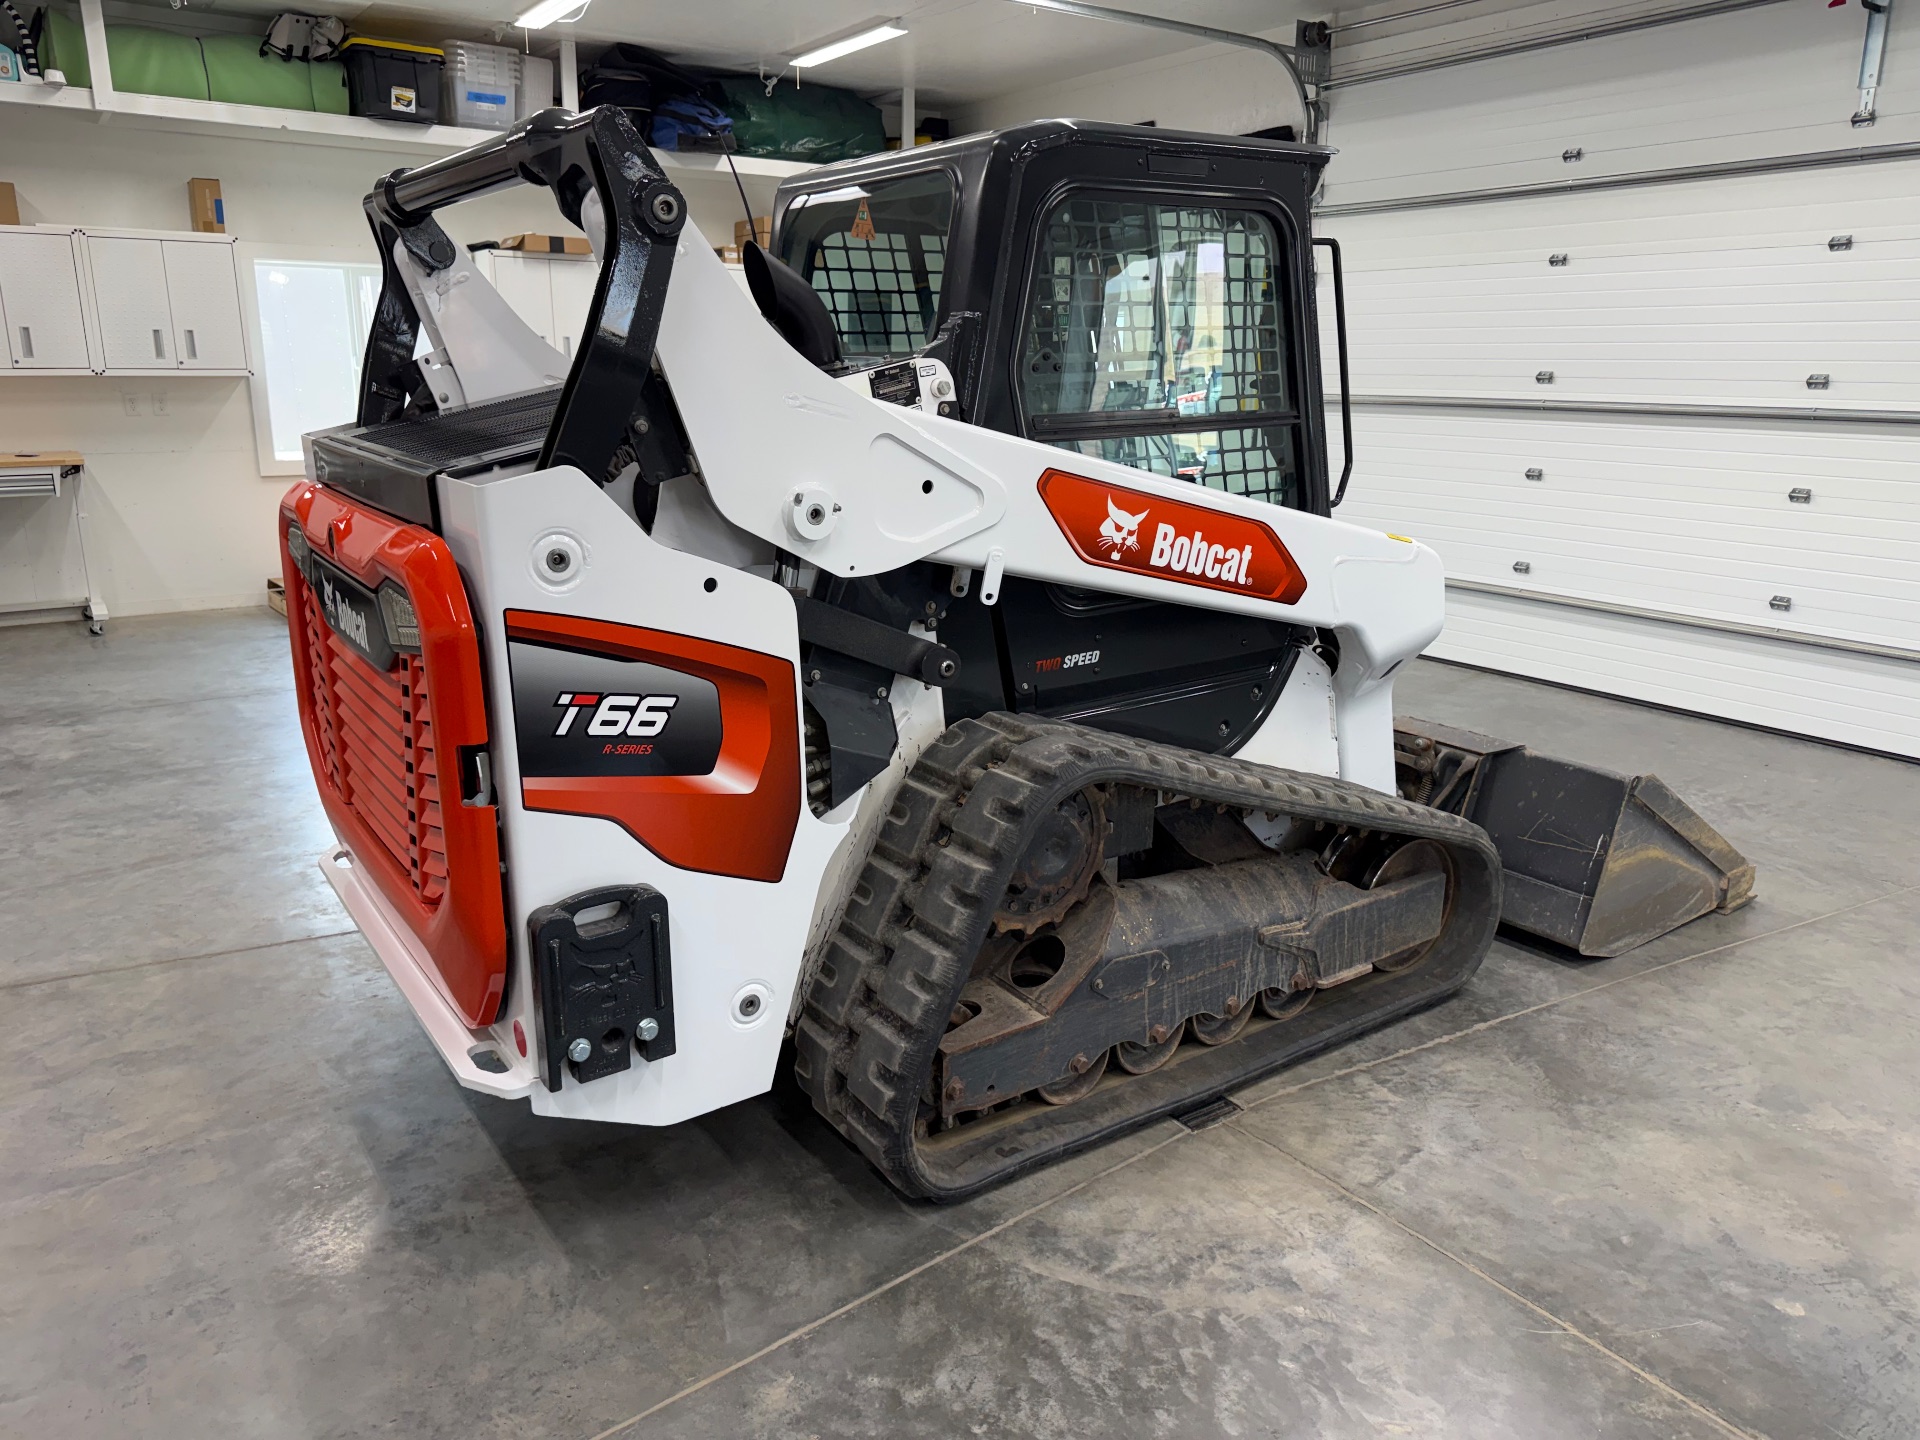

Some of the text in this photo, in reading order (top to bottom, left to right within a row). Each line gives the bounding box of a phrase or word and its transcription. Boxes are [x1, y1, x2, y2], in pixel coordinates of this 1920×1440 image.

[1150, 522, 1252, 585] Bobcat
[335, 590, 370, 653] Bobcat
[1036, 650, 1100, 673] TWO SPEED
[553, 692, 678, 737] T66
[602, 743, 654, 755] R-SERIES
